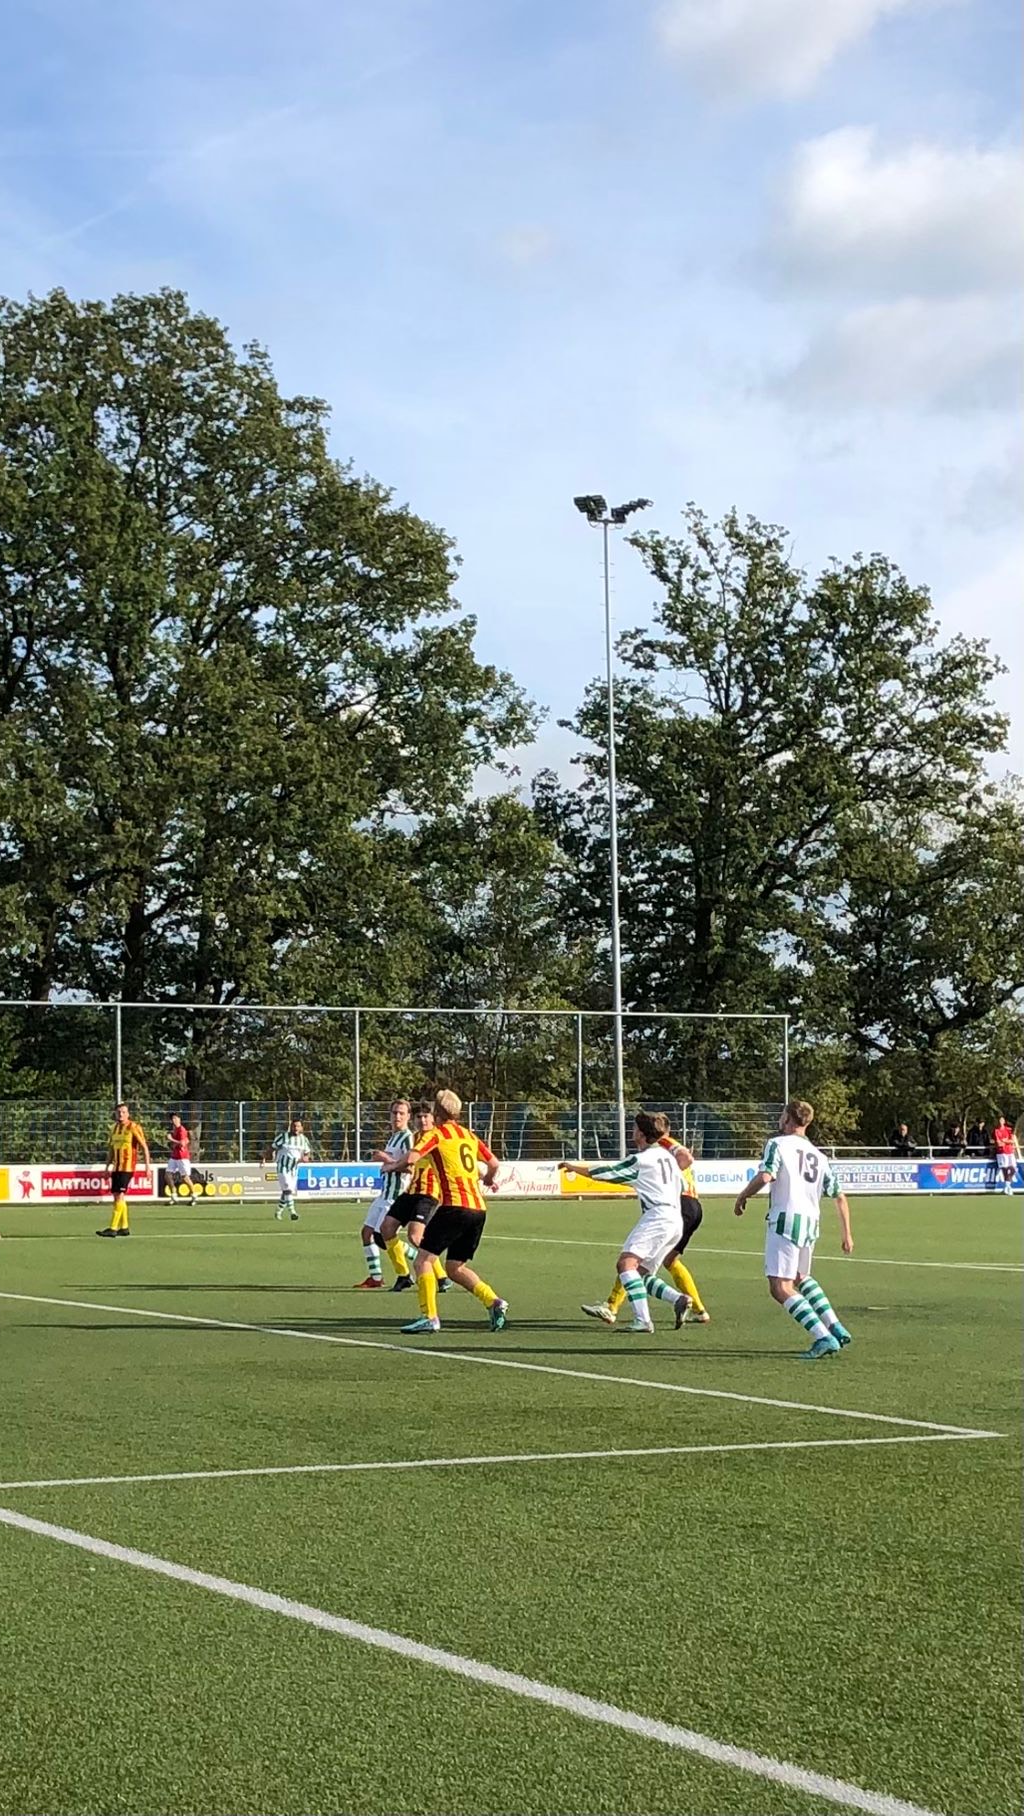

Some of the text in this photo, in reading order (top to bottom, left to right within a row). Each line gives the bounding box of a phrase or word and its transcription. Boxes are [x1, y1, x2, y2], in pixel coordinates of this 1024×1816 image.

[459, 1143, 475, 1173] 6
[796, 1149, 819, 1183] 13
[307, 1168, 374, 1187] baderie
[657, 1158, 673, 1184] 11
[852, 1173, 892, 1182] HEETEN
[894, 1173, 913, 1182] B.V.
[951, 1167, 1018, 1183] WICHIN
[42, 1178, 112, 1190] HARTHOL
[515, 1181, 558, 1194] Nijkamp
